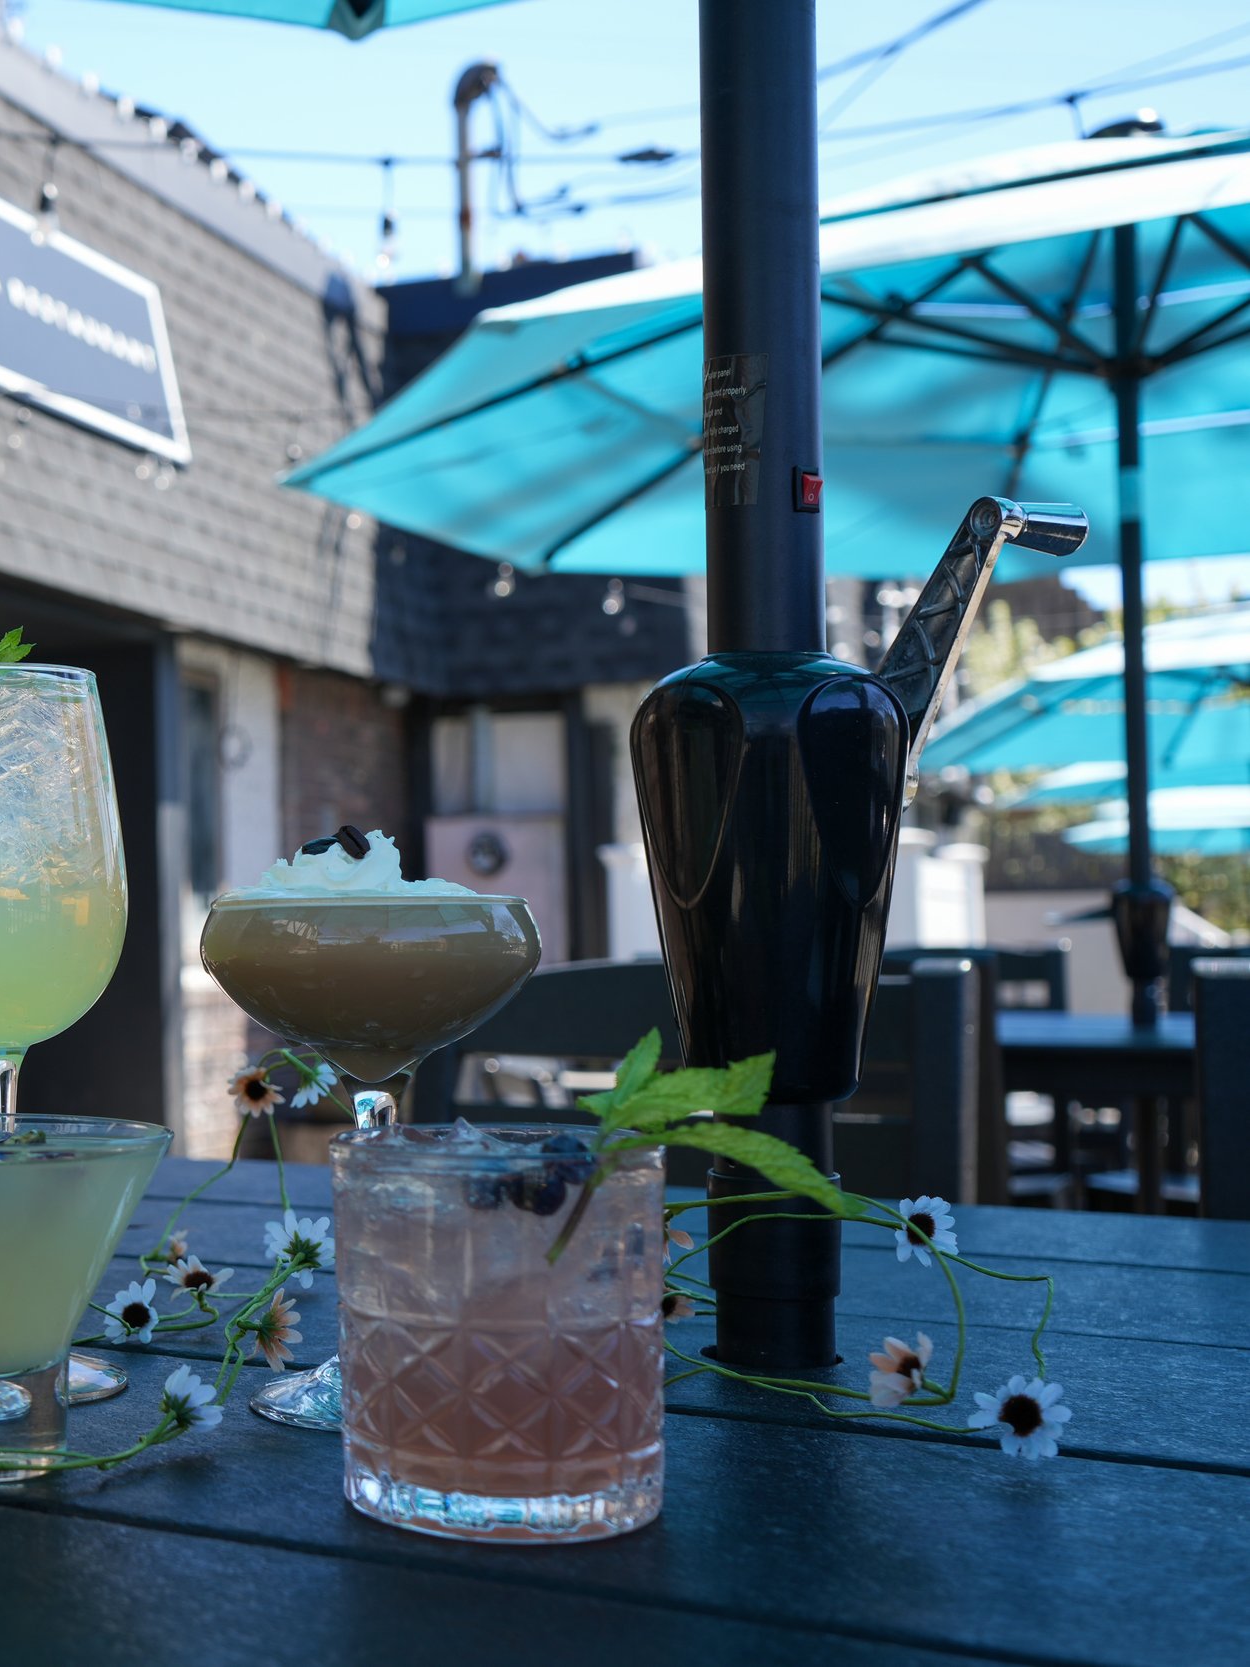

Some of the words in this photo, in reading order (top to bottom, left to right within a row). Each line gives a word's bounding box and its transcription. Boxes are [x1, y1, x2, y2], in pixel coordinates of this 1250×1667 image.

[722, 385, 748, 397] properly.
[718, 423, 739, 436] charged
[727, 443, 742, 454] using
[720, 465, 730, 474] you
[730, 462, 745, 471] need
